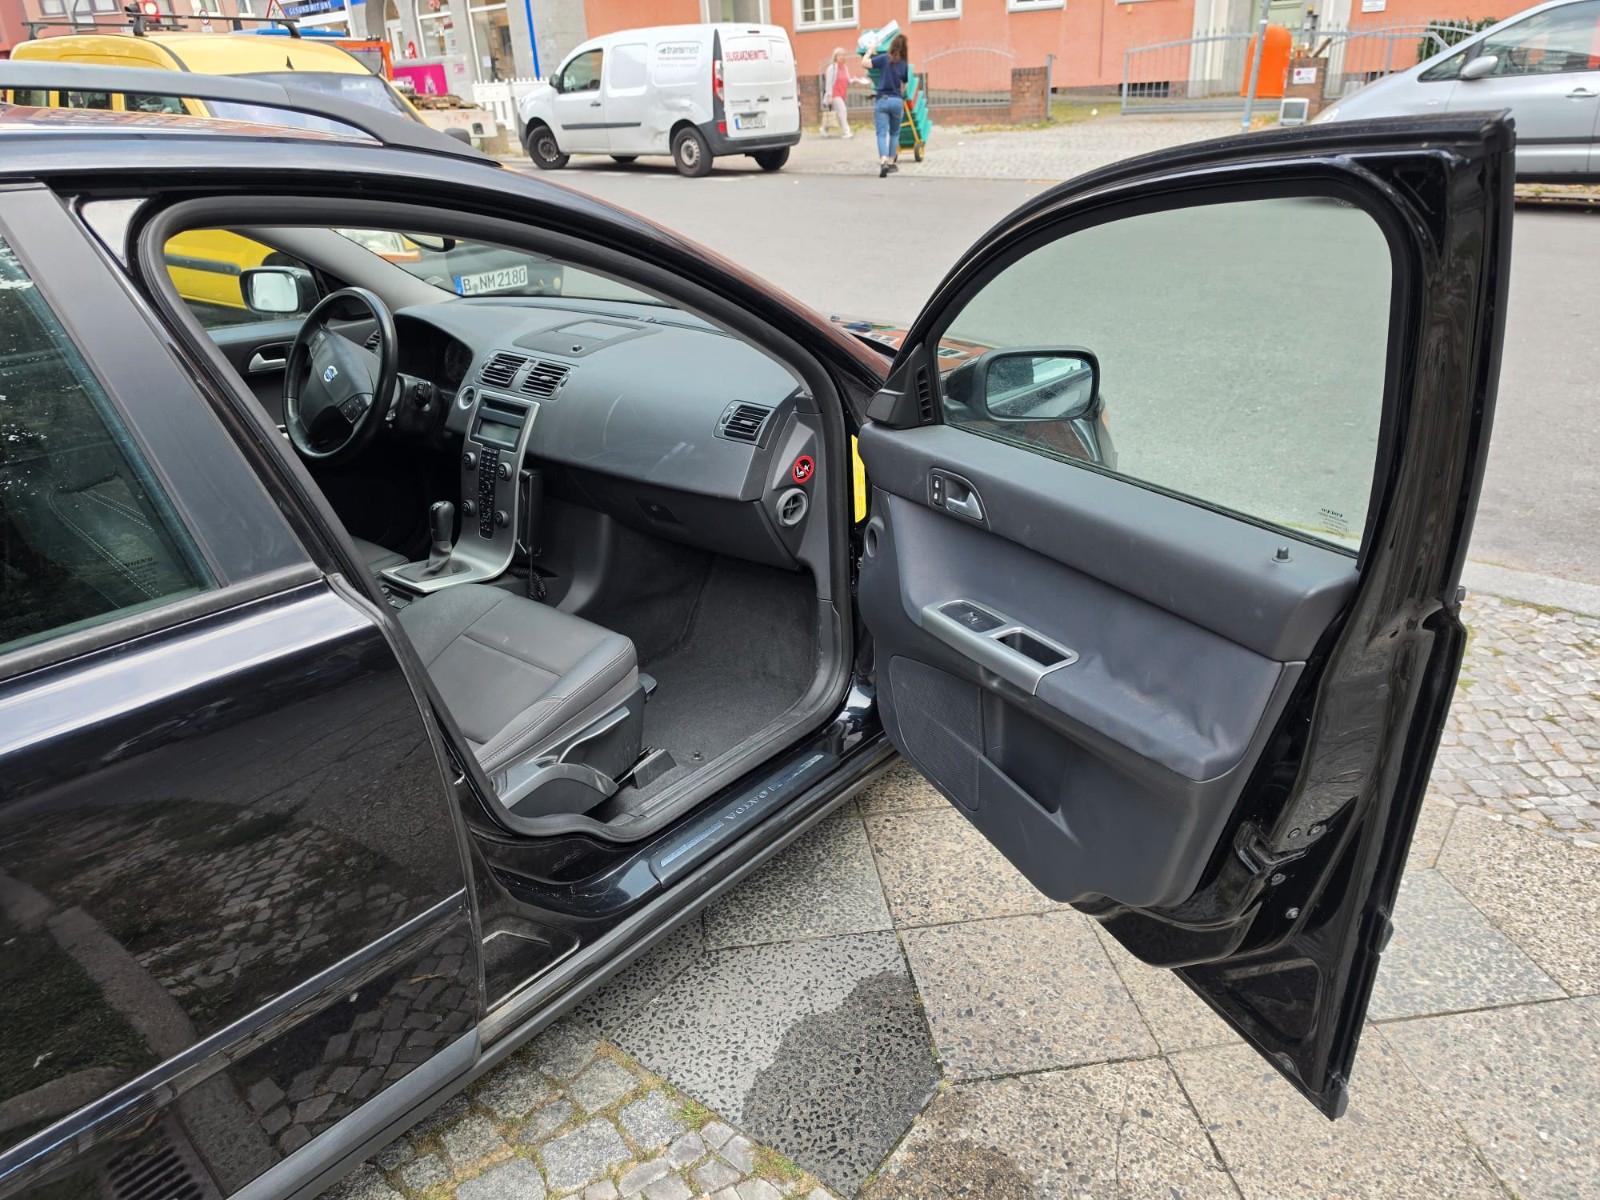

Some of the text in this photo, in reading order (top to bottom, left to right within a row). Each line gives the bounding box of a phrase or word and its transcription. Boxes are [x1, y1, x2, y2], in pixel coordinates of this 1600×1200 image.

[463, 268, 526, 292] B NM 2180
[723, 790, 769, 820] VOLVO
